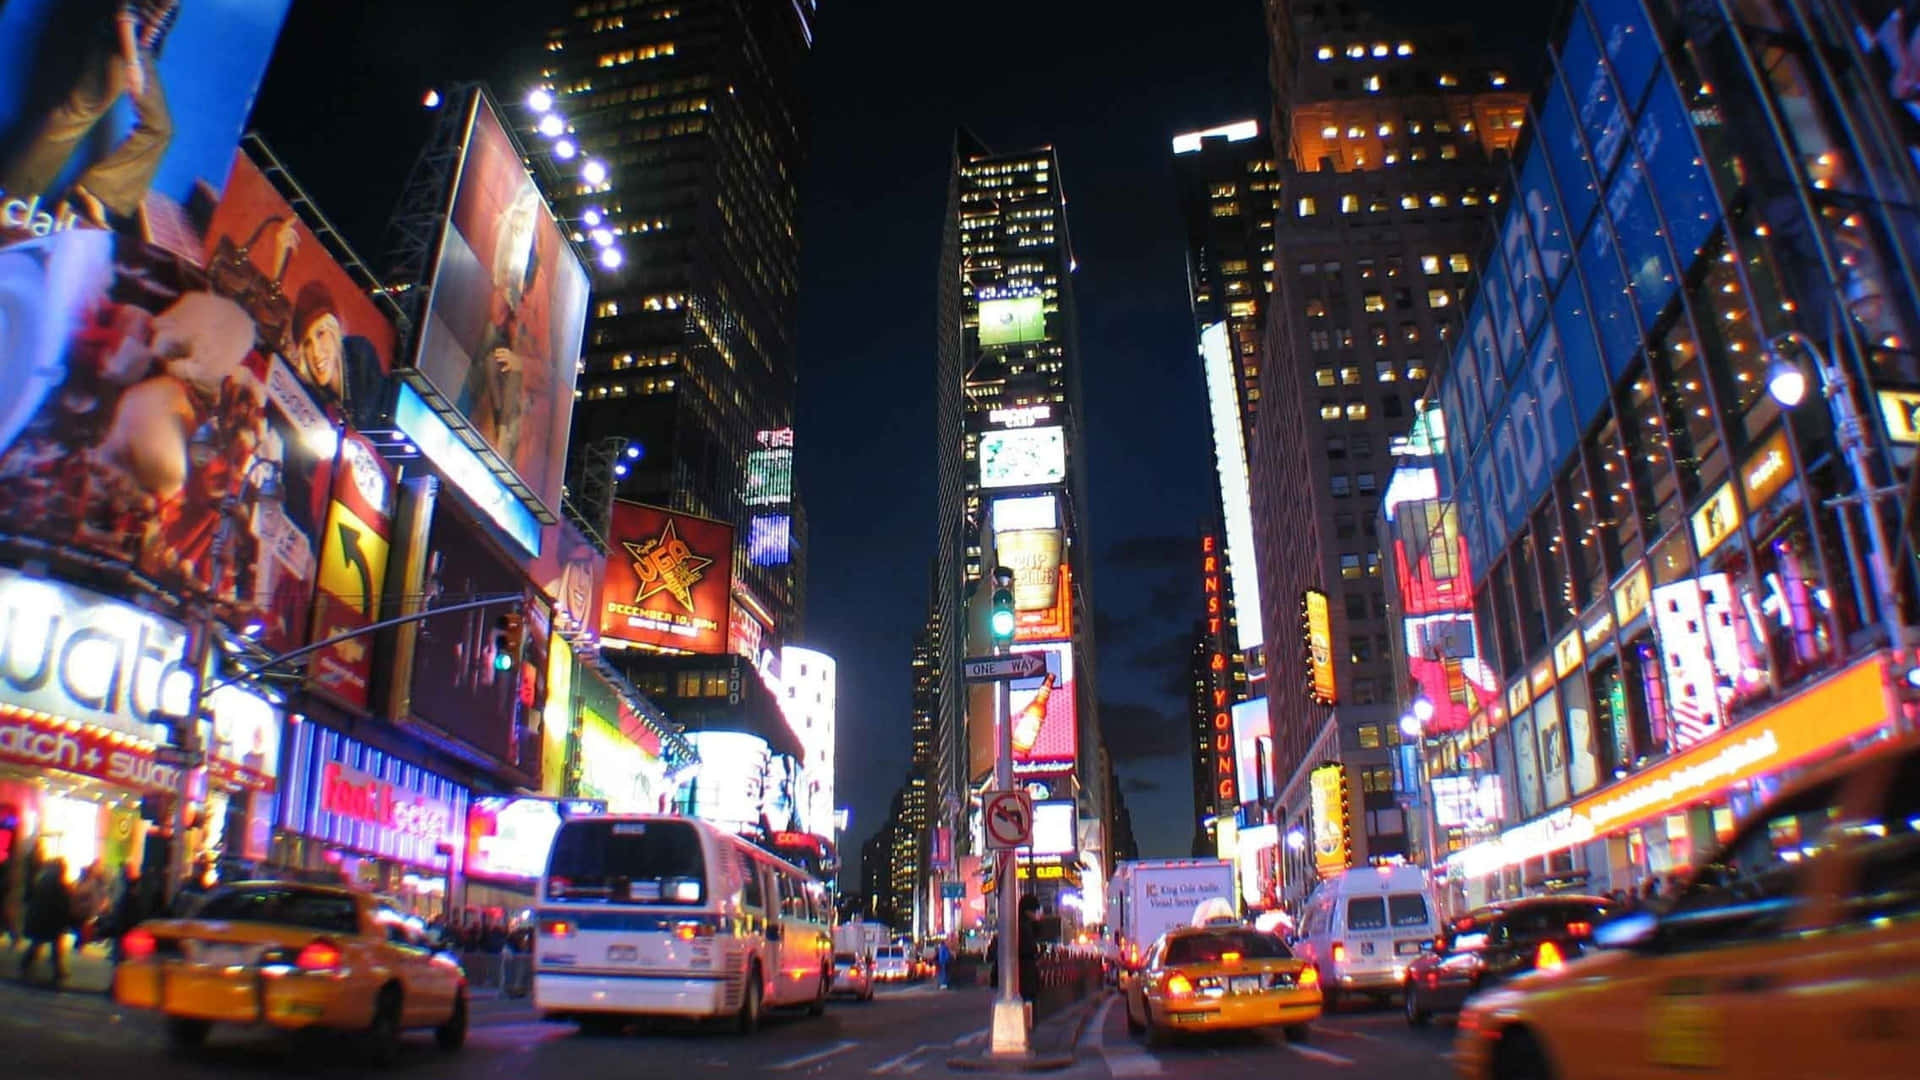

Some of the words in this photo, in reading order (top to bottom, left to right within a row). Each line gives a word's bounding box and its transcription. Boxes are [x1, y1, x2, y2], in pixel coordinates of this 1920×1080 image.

[1203, 537, 1220, 633] ERNST
[607, 602, 672, 622] DECEMBER
[972, 663, 996, 675] ONE
[1012, 658, 1036, 671] WAY
[1211, 654, 1224, 669] &
[1214, 690, 1233, 797] YOUNG
